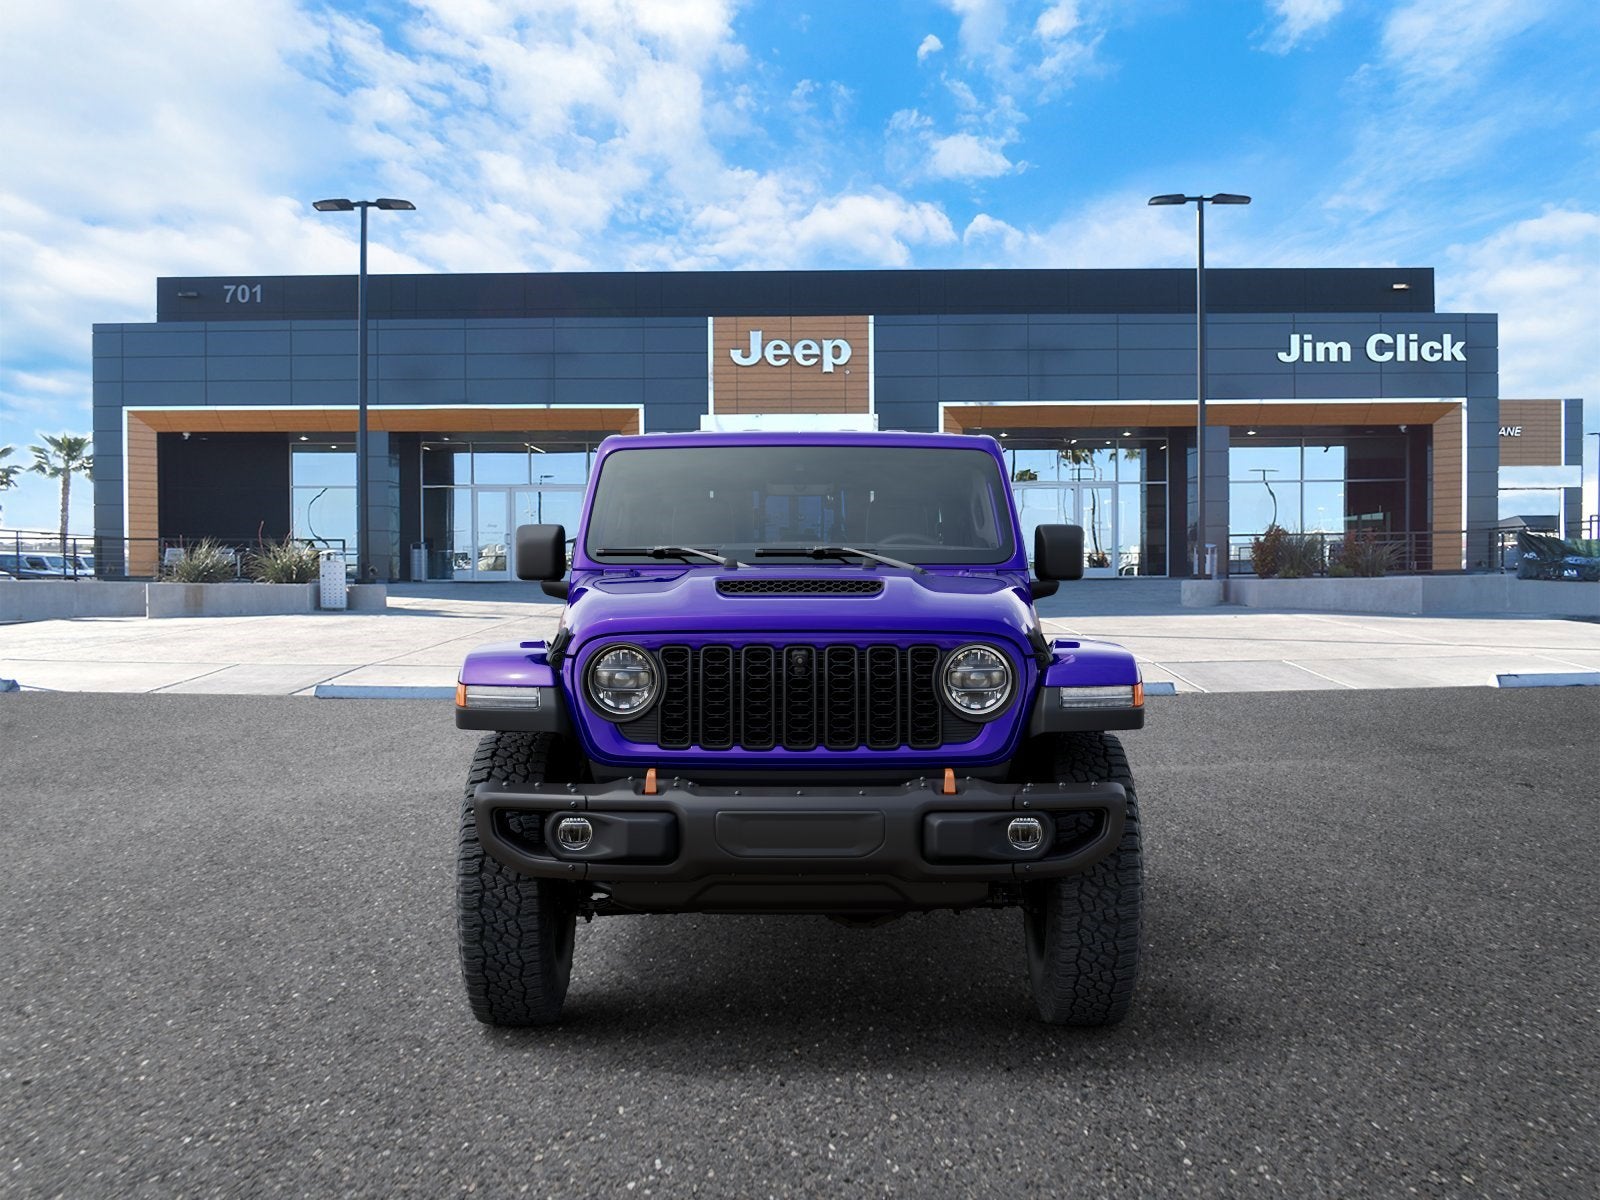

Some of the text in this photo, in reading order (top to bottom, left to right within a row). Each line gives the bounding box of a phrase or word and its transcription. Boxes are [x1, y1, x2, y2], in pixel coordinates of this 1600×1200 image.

[223, 284, 262, 303] 701
[729, 330, 852, 373] Jeep
[1277, 333, 1467, 363] Jim Click
